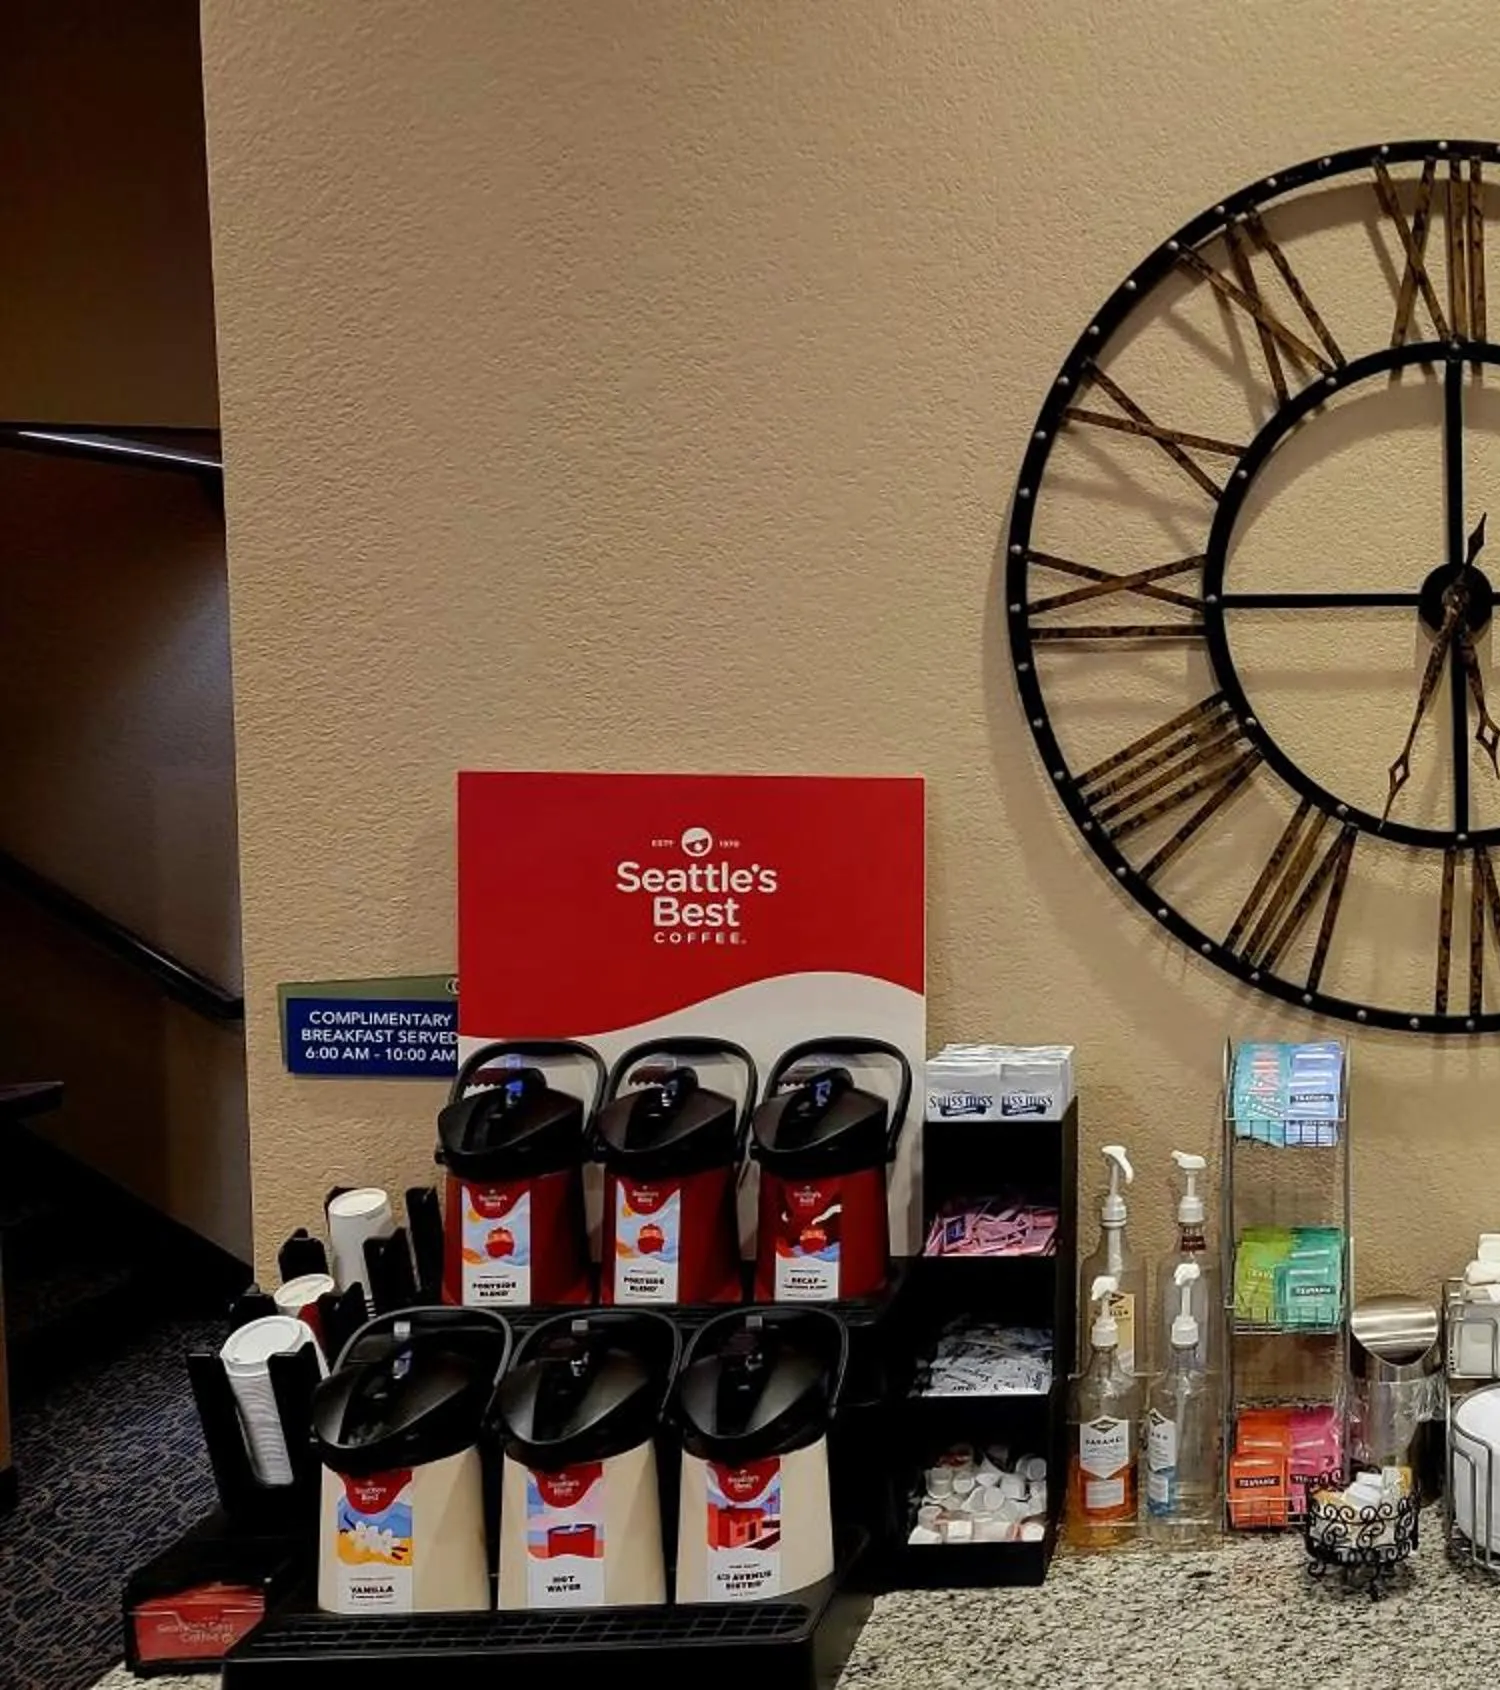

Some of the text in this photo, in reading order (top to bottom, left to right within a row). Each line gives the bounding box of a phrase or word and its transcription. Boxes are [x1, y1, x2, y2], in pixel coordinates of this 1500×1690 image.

[616, 860, 778, 893] Seattle's
[653, 896, 740, 927] Best
[653, 931, 747, 945] COFFEE
[309, 1011, 452, 1027] COMPLIMENTARY
[301, 1028, 394, 1043] BREAKFAST
[305, 1047, 339, 1060] 6:00
[342, 1048, 369, 1060] AM
[385, 1048, 427, 1061] 10:00
[430, 1049, 456, 1061] AM
[552, 1575, 575, 1583] HOT
